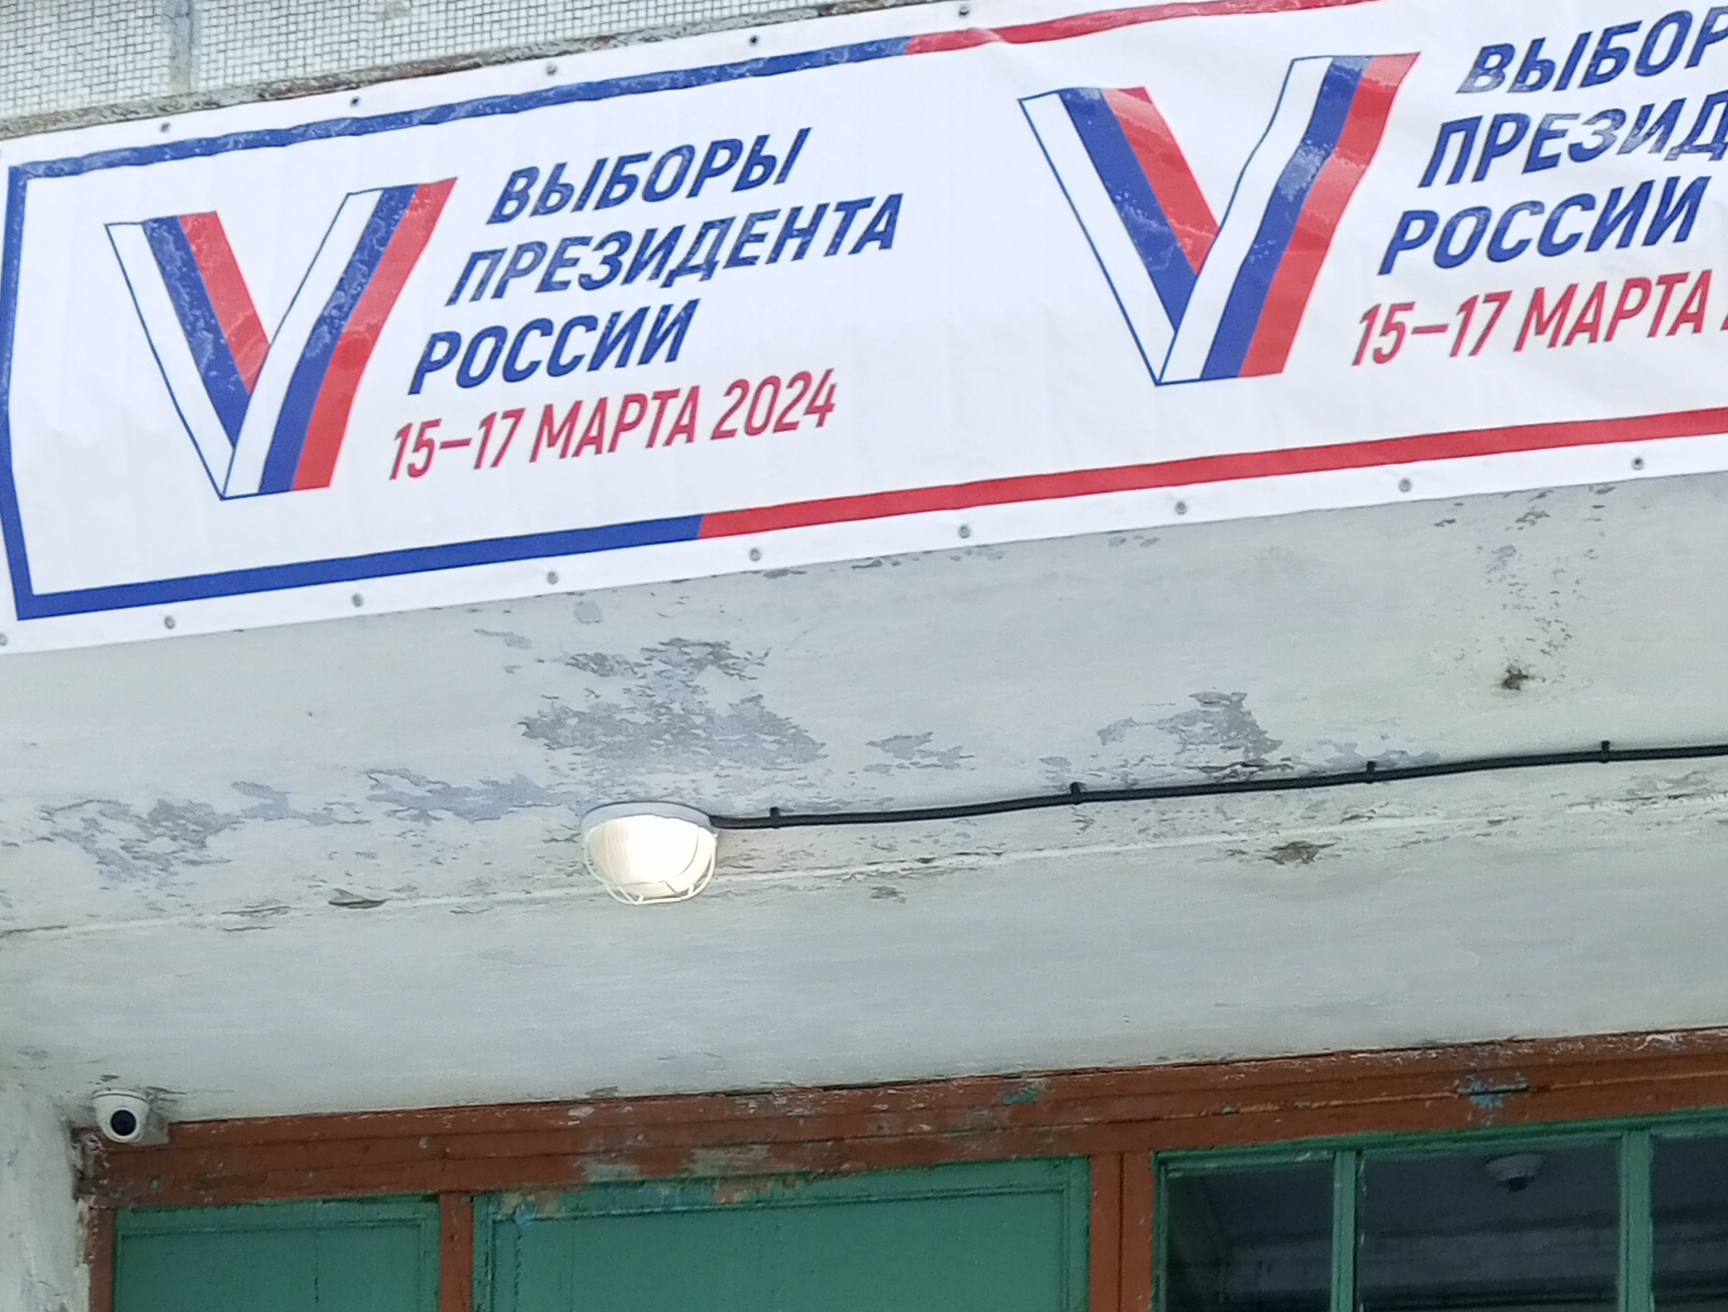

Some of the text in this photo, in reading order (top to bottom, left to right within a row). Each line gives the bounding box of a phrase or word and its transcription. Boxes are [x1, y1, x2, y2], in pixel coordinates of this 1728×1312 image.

[486, 126, 814, 226] ВЫБОРЫ
[1379, 175, 1712, 276] РОССИИ
[446, 192, 905, 307] ПРЕЗИДЕНТА
[411, 298, 702, 396] РОССИИ
[1515, 270, 1713, 353] МАРТА
[532, 386, 702, 462] МАРТА
[711, 370, 837, 440] 2024
